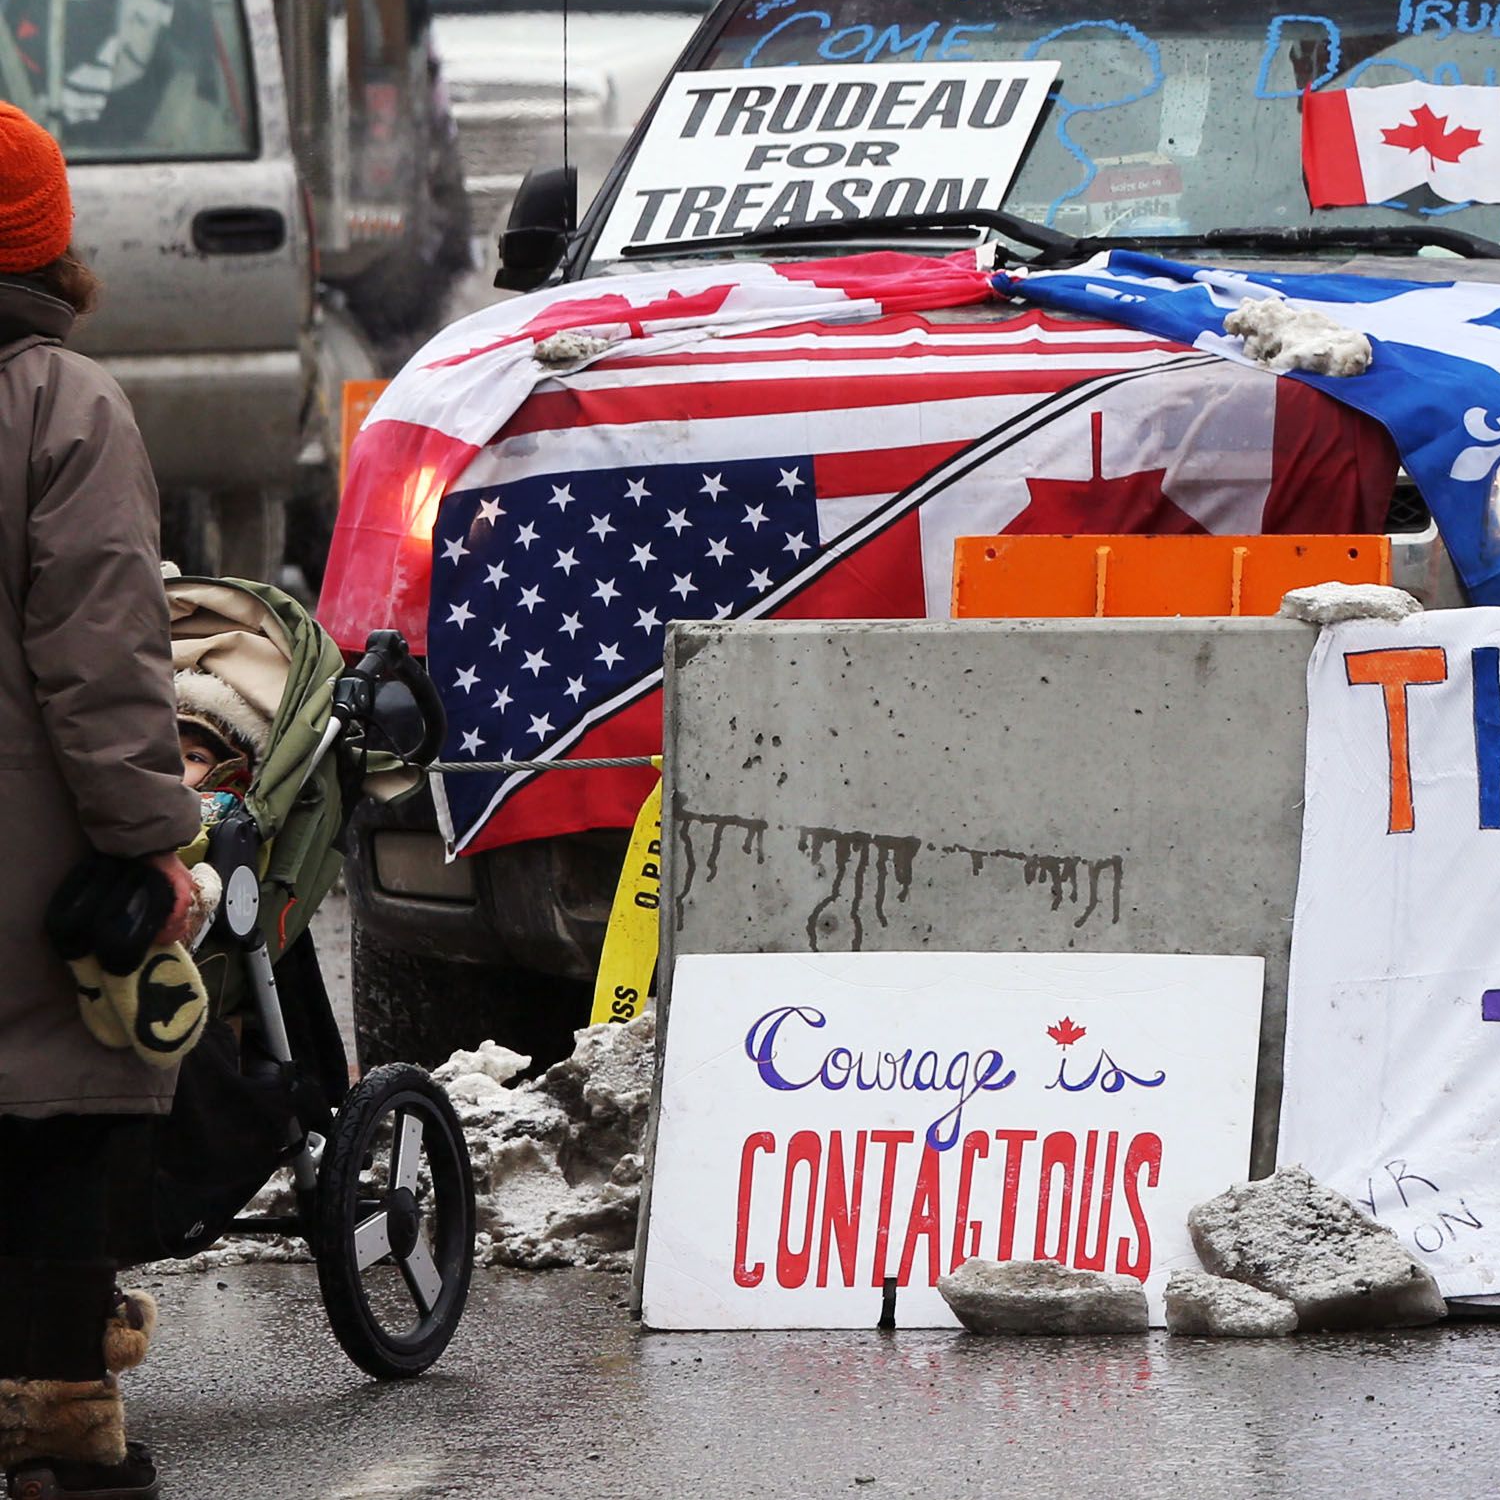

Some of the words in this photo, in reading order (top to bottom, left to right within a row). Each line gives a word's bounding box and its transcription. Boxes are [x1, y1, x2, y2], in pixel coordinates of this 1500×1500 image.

[743, 10, 998, 69] COME
[679, 77, 1029, 140] TRUDEAU
[745, 140, 900, 172] FOR
[745, 1006, 1017, 1153] Courage
[1045, 1030, 1167, 1094] is
[1413, 1198, 1483, 1254] ON
